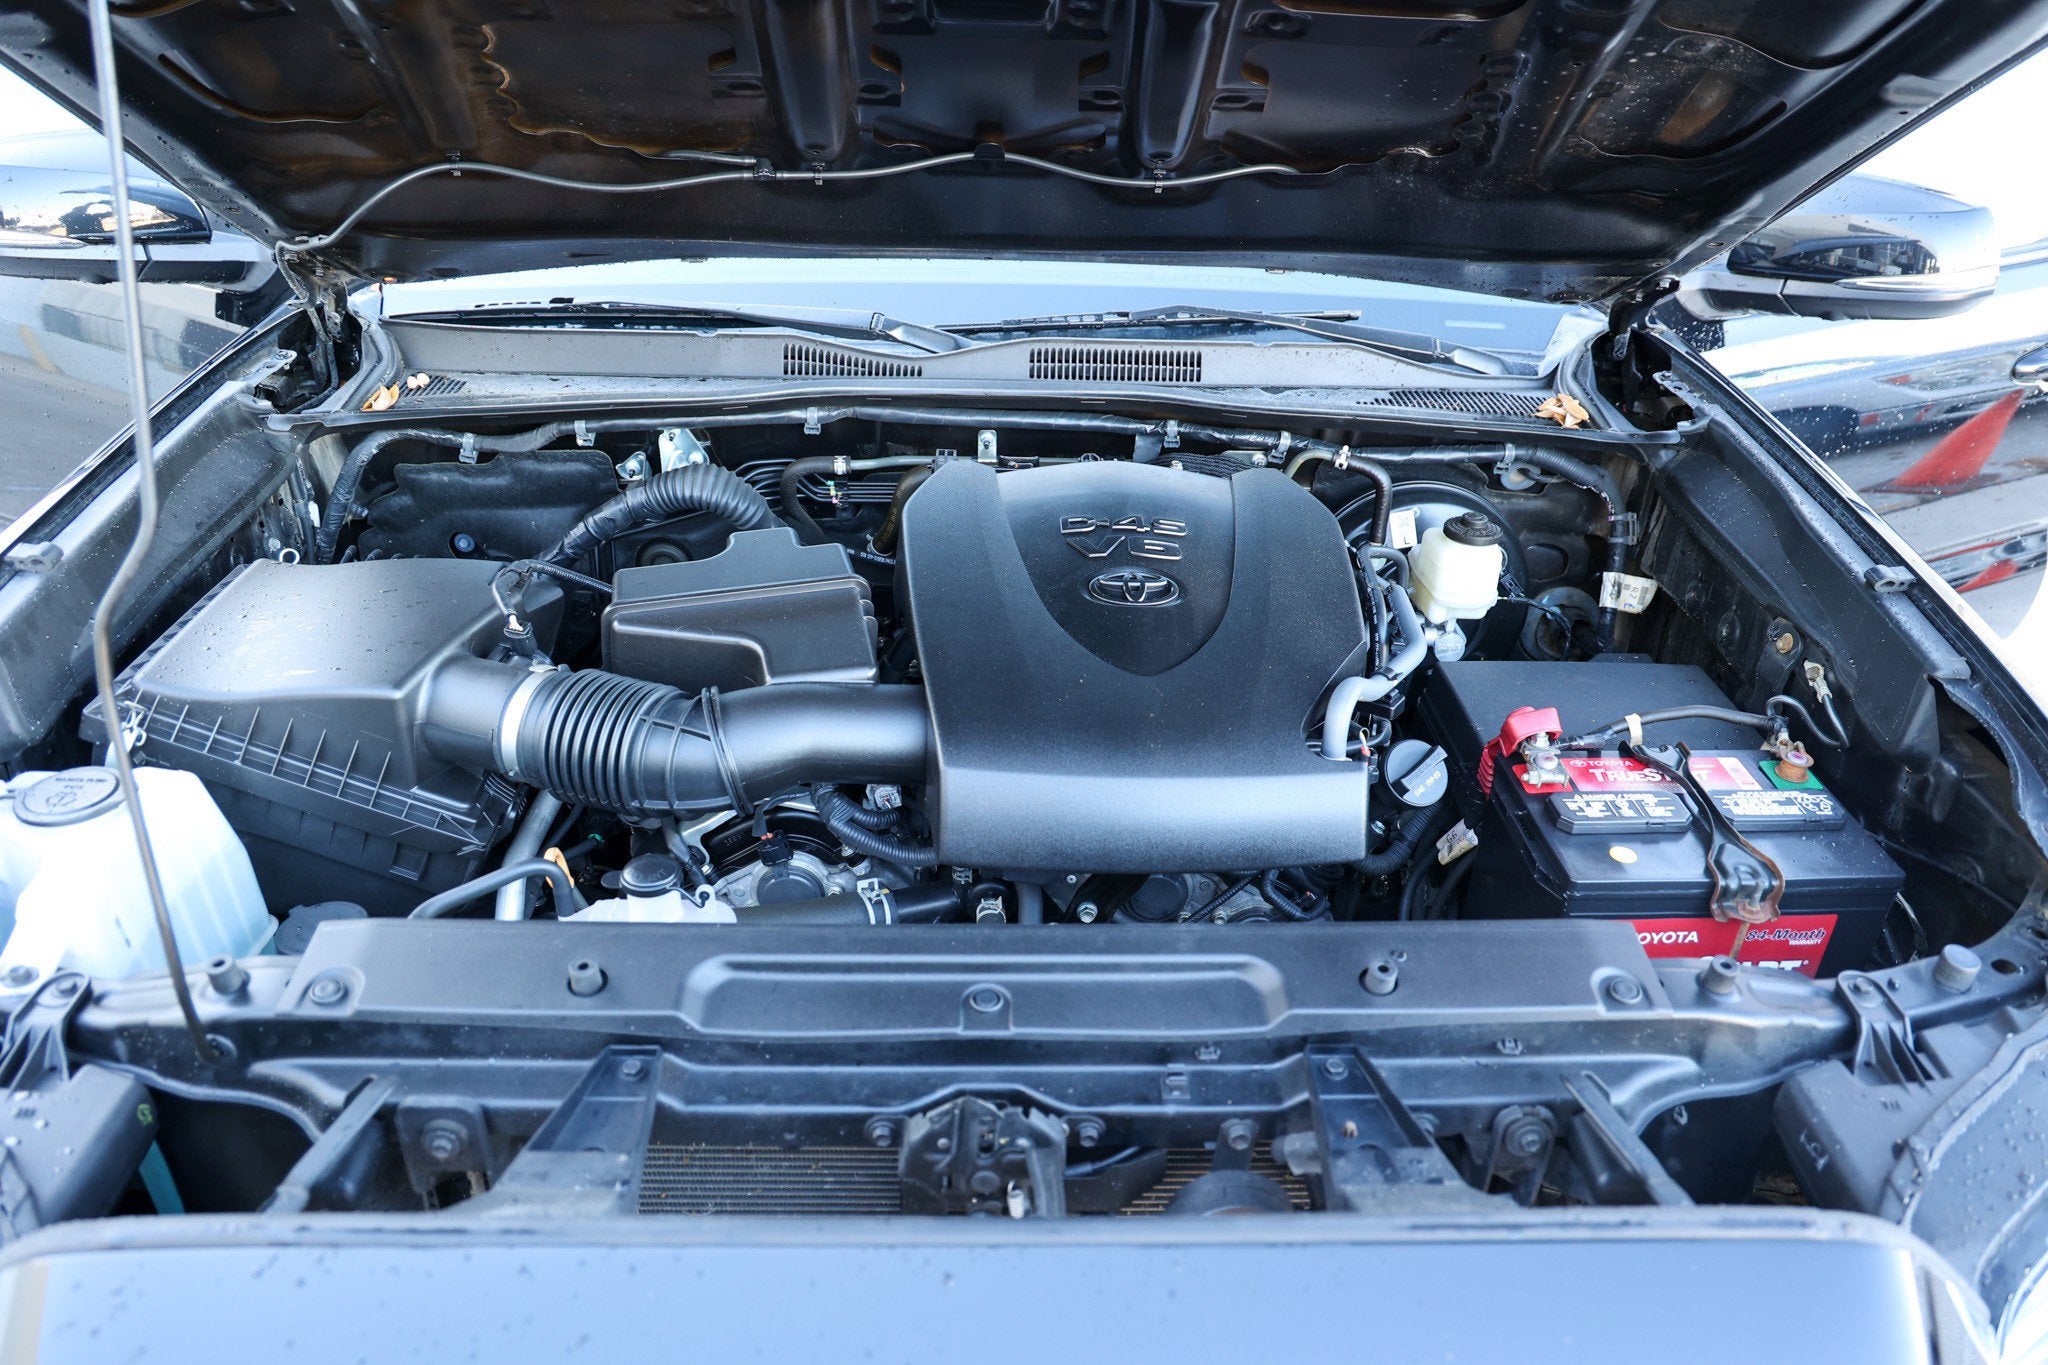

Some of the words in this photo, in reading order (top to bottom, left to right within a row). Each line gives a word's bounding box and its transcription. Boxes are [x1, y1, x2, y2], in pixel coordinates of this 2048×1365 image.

[1060, 515, 1190, 536] D-4S
[1065, 535, 1183, 560] V6
[1745, 928, 1826, 941] 84-Month
